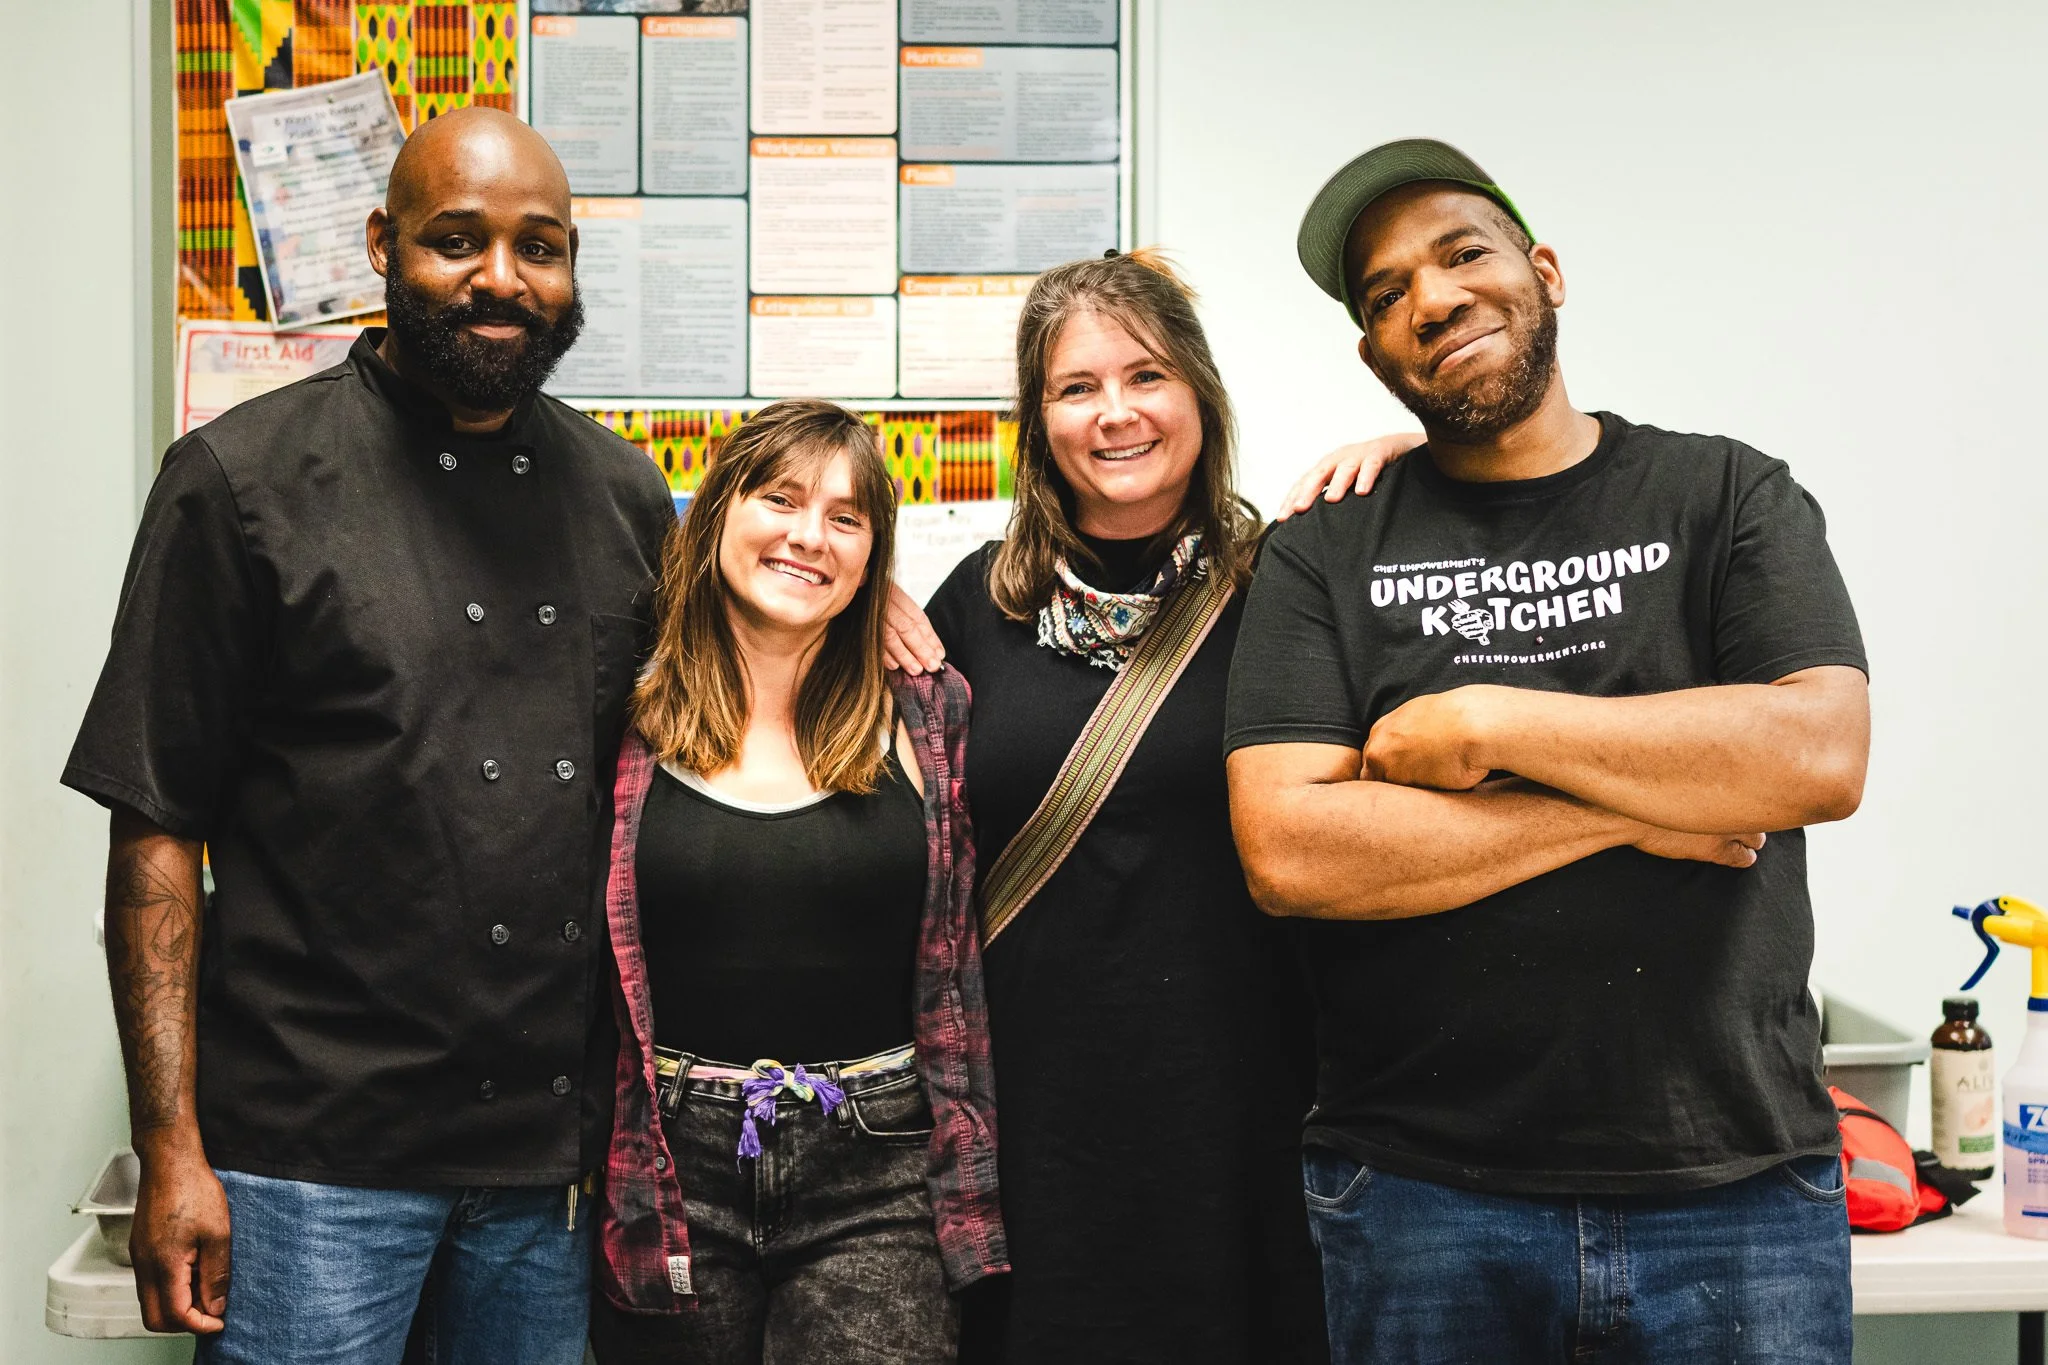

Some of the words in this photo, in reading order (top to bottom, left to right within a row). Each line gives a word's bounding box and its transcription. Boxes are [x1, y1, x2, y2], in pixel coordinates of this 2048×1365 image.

[222, 340, 271, 361] First
[279, 341, 316, 362] Aid
[1370, 542, 1670, 607] UNDERGROUND
[1373, 563, 1399, 574] CHEF
[1400, 557, 1486, 572] EMPOWERMENT'S
[1421, 583, 1622, 637] KTCHEN
[1453, 641, 1606, 664] CHEFEMPOWERMENT.ORG
